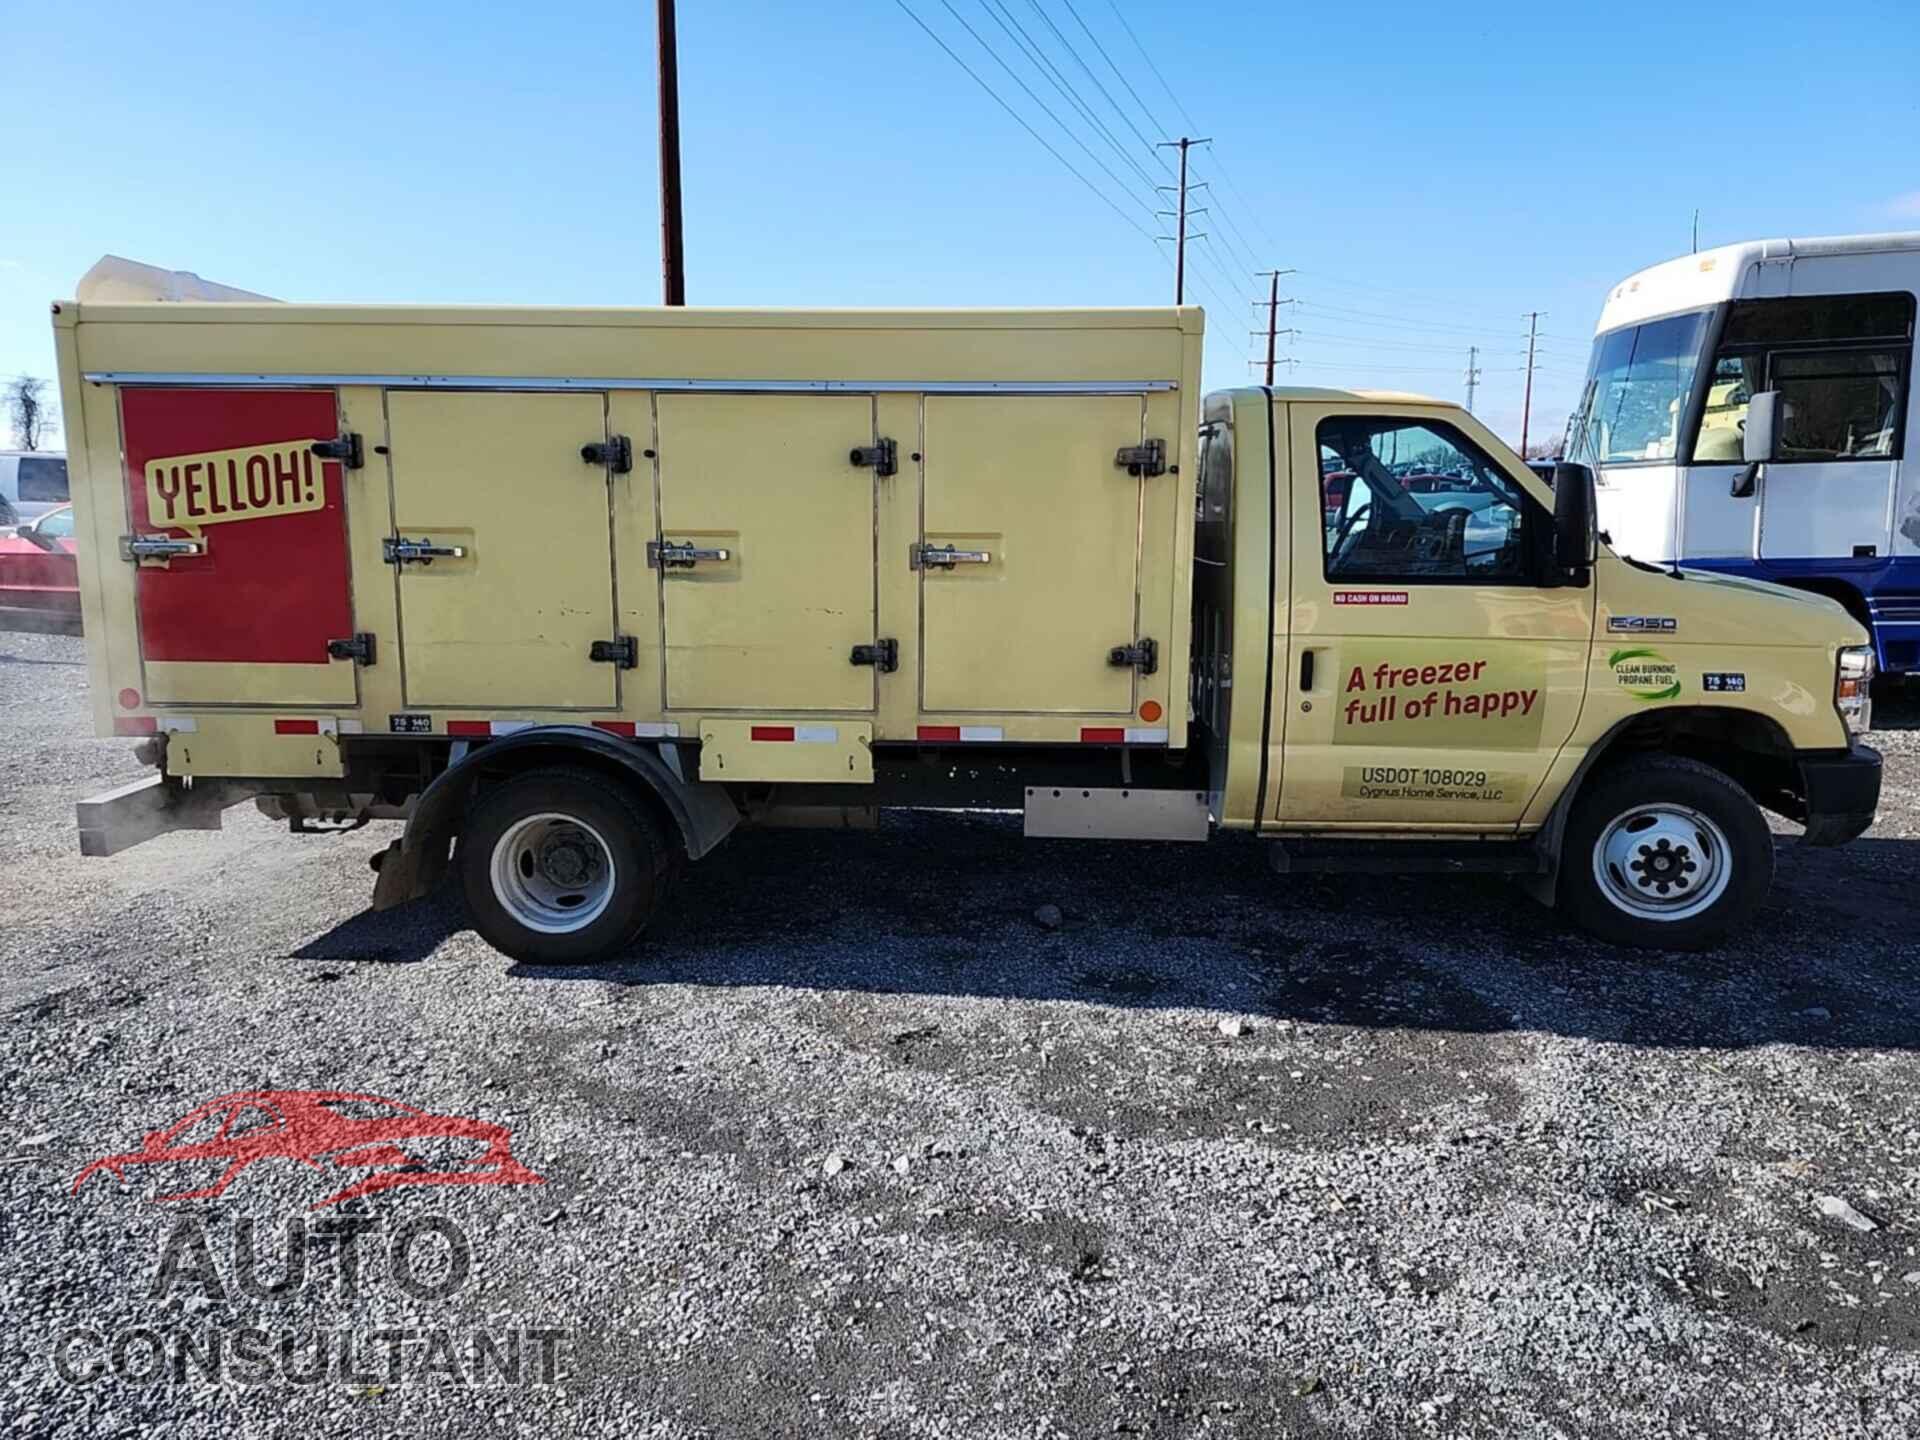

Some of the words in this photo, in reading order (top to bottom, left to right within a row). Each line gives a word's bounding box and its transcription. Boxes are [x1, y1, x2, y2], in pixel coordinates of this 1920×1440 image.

[155, 449, 315, 519] YELLOH!
[1335, 594, 1346, 603] NO
[1347, 594, 1368, 603] CASH
[1368, 594, 1380, 603] ON
[1381, 594, 1407, 603] BOARD
[1345, 666, 1366, 693] A
[1373, 660, 1487, 690] freezer
[1616, 664, 1640, 674] CLEAN
[1641, 664, 1676, 674] BURNING
[1618, 675, 1653, 685] PROPANE
[1655, 675, 1674, 685] FUEL
[1344, 695, 1397, 725] full
[1404, 692, 1438, 720] of
[1444, 689, 1539, 720] happy
[1361, 767, 1420, 785] USDOT
[1422, 768, 1487, 788] 108029
[1359, 785, 1401, 799] Cygnus
[1402, 786, 1435, 798] Home
[1436, 788, 1480, 801] Service,
[1482, 789, 1503, 801] LLC
